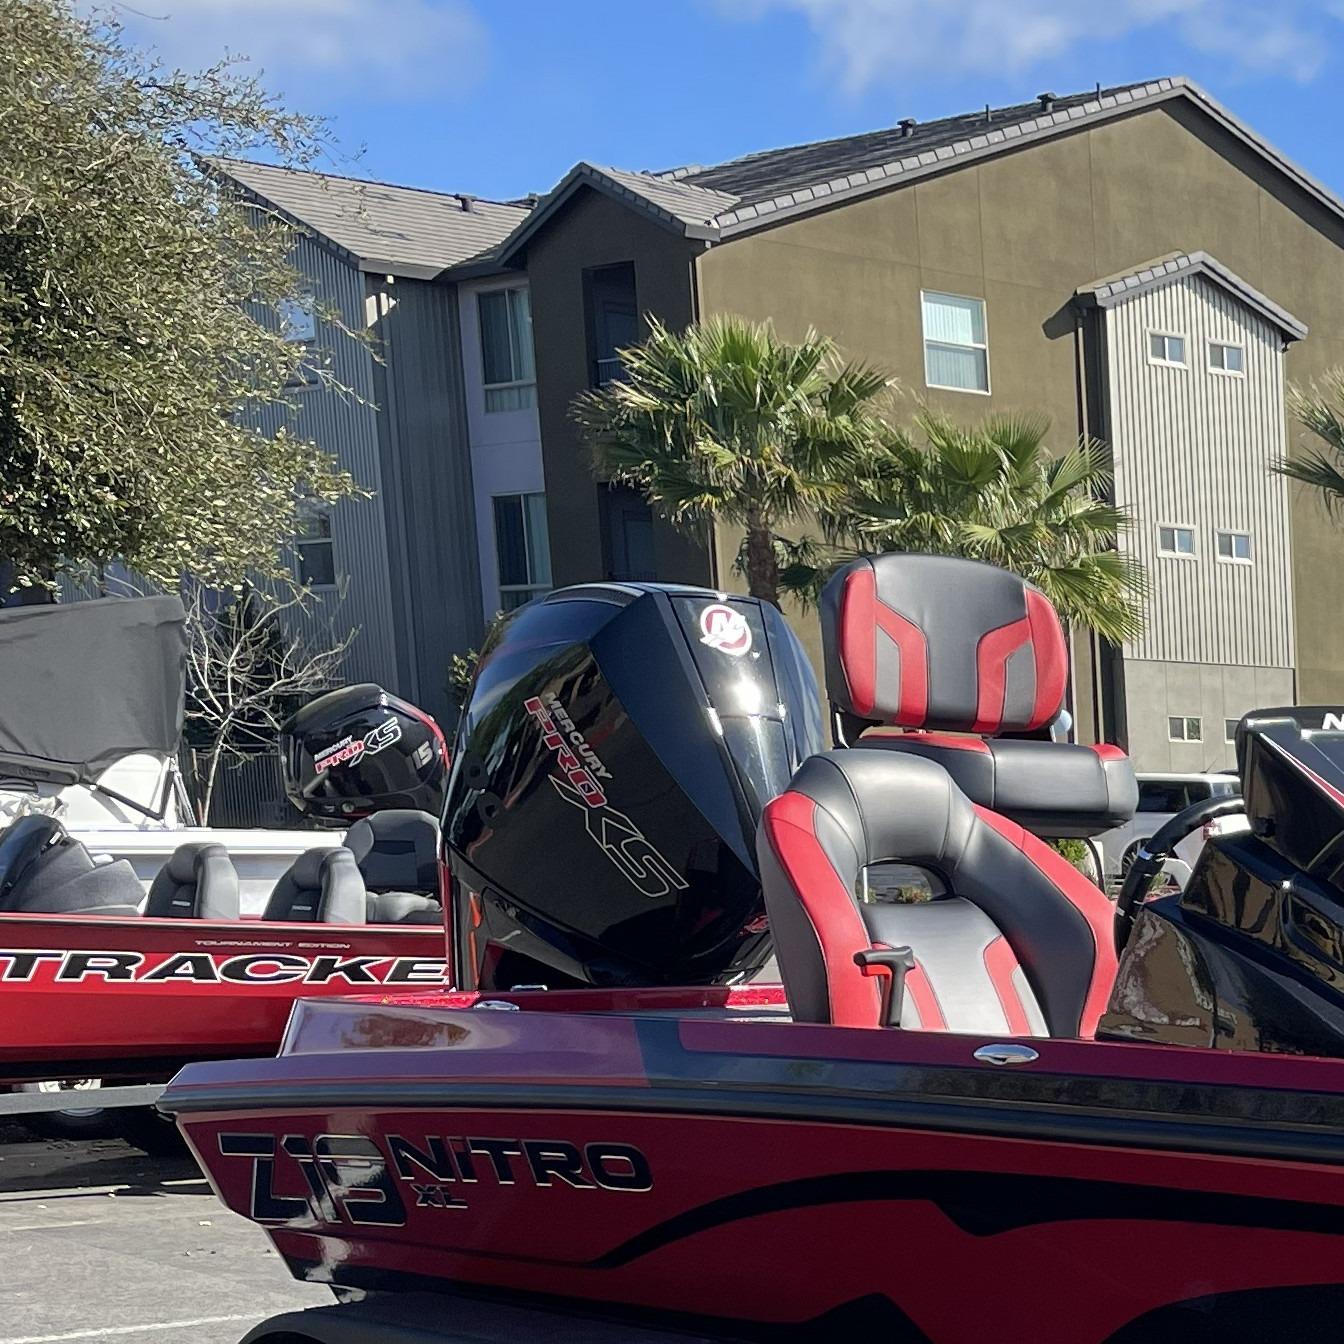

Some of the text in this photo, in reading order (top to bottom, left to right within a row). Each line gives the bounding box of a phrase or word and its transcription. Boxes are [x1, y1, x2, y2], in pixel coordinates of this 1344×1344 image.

[349, 716, 402, 767] XS
[547, 692, 613, 779] MERCURY
[524, 696, 689, 897] PRO XS
[0, 949, 450, 985] TRACKE
[410, 1183, 469, 1209] XL
